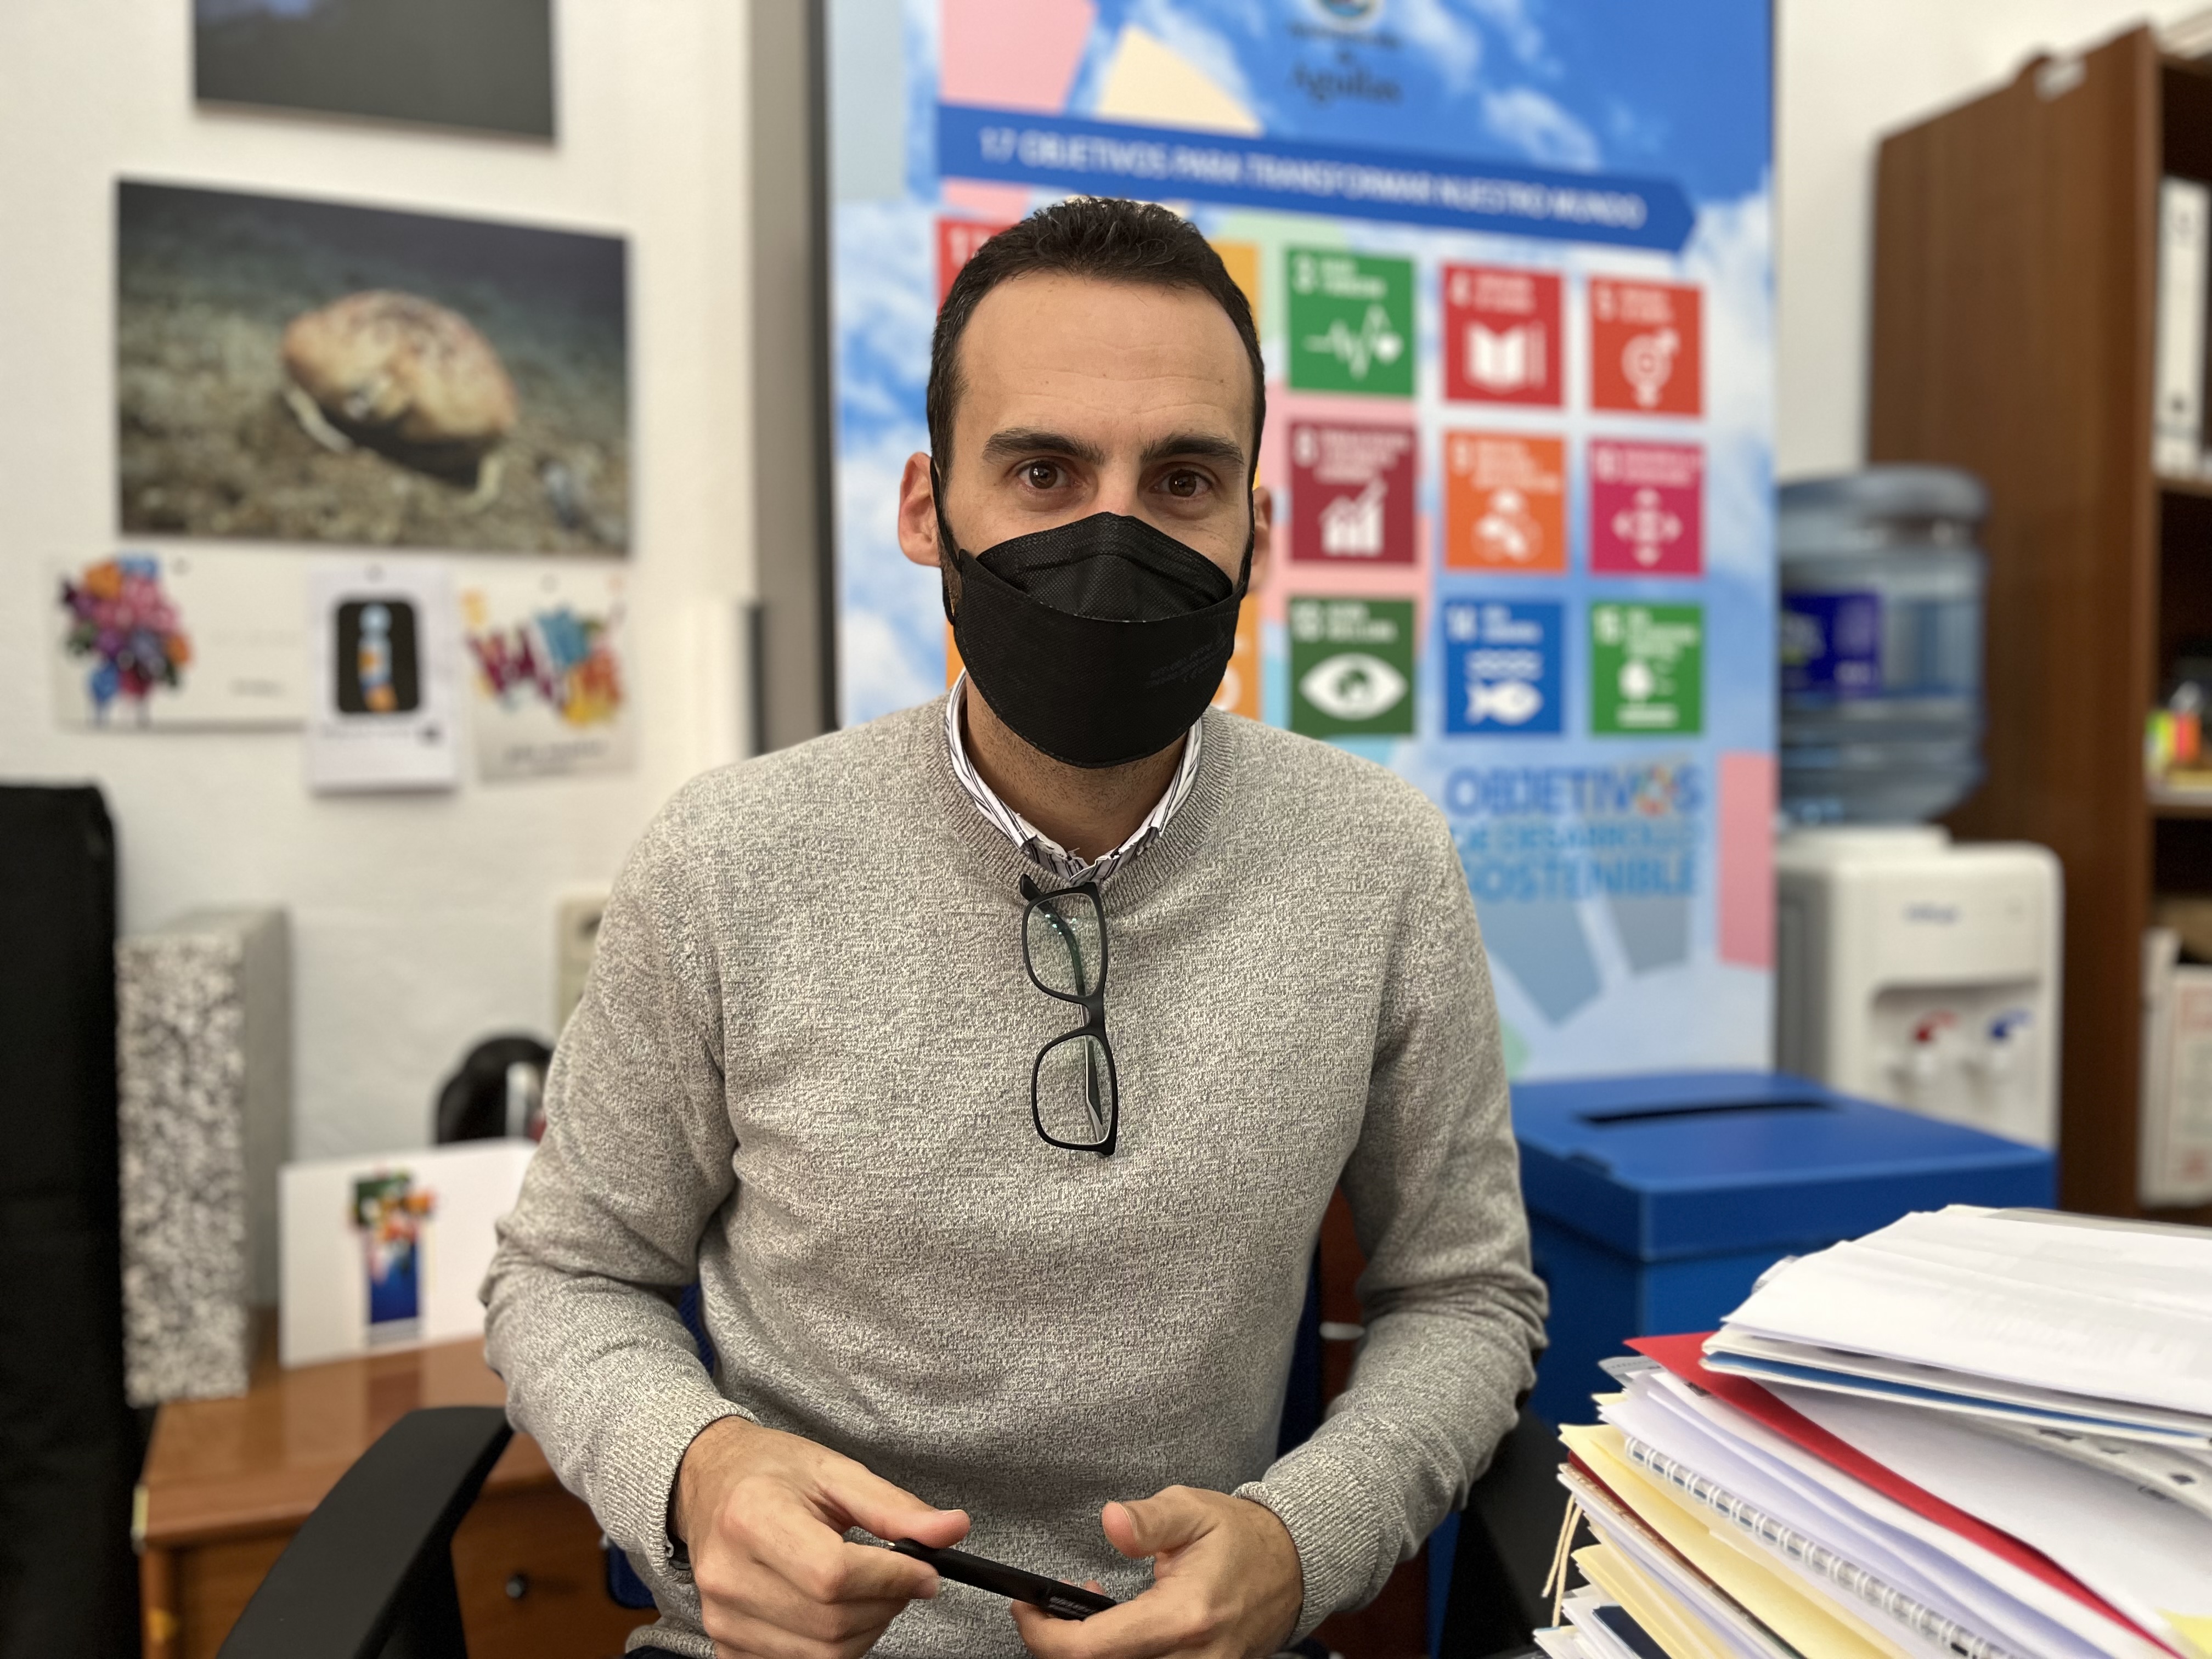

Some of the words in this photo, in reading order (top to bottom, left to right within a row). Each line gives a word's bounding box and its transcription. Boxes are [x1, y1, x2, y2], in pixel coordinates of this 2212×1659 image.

[980, 127, 1017, 162] 17
[1018, 131, 1167, 179] OBJETIVOS
[1170, 144, 1242, 187] PARA
[1245, 153, 1432, 206] TRANSFORMAR
[1434, 174, 1550, 219] NUESTRO
[1551, 187, 1647, 230] MUNDO
[1444, 765, 1704, 816] OBJETIVOS
